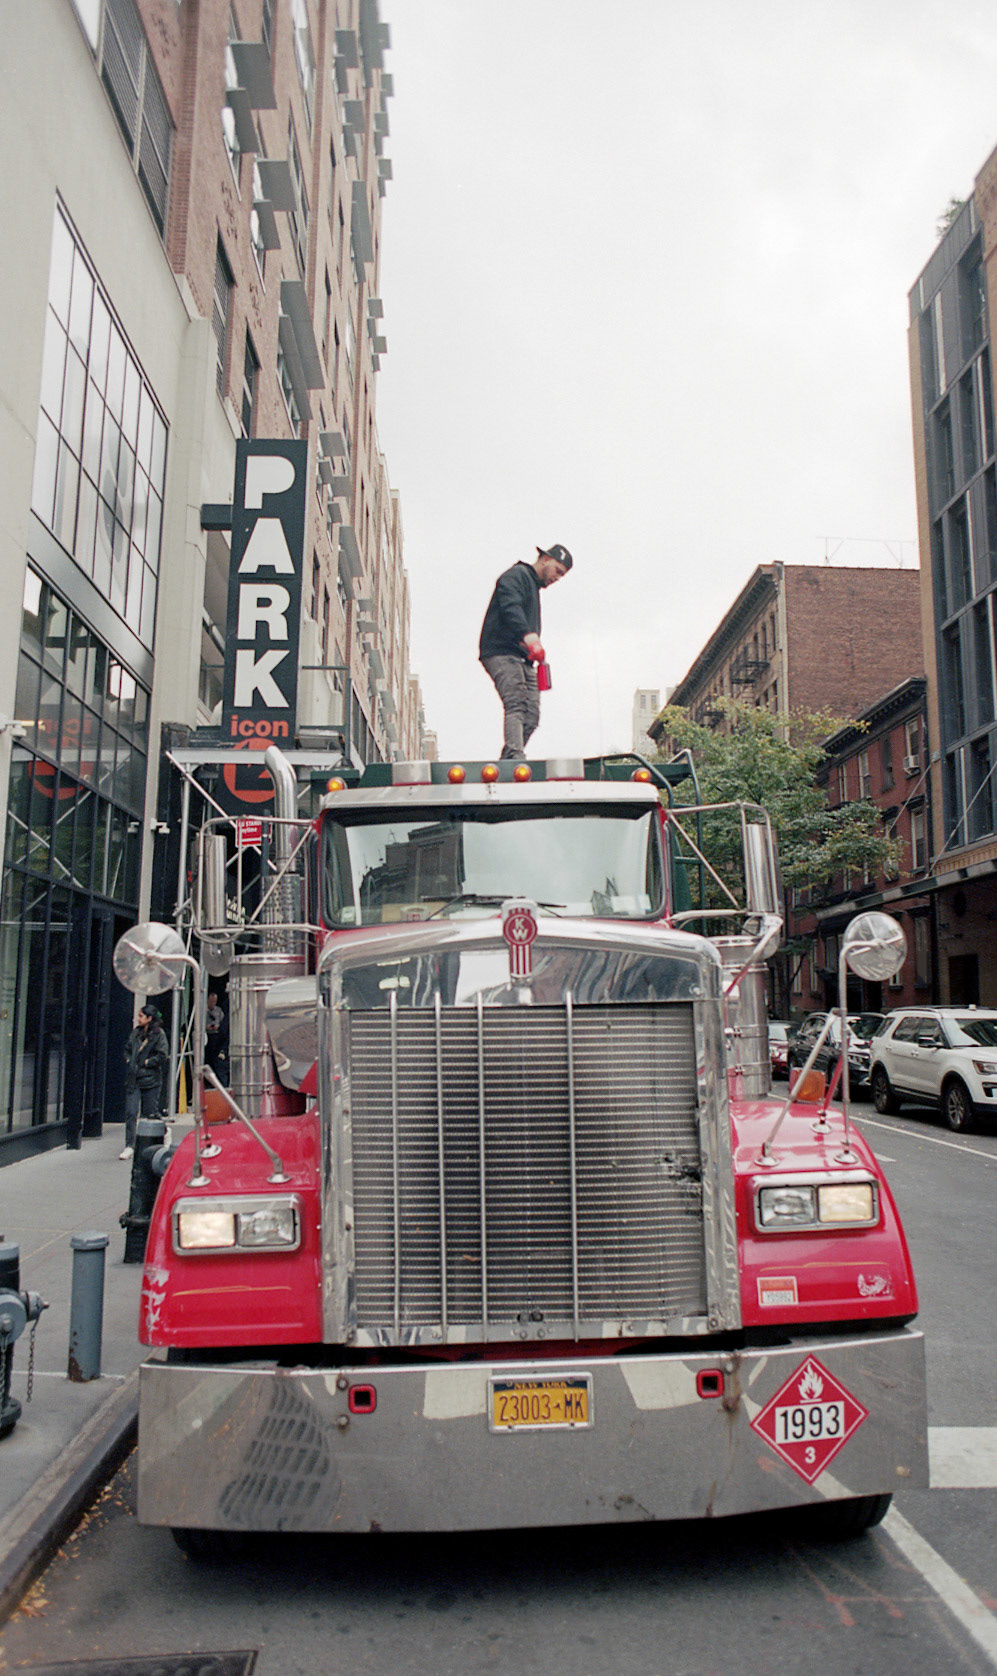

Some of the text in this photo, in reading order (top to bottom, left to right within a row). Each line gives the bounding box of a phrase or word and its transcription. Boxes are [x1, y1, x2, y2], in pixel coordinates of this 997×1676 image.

[233, 455, 296, 709] PARK
[230, 714, 289, 738] icon
[780, 1405, 840, 1441] 1993
[804, 1446, 816, 1464] 3
